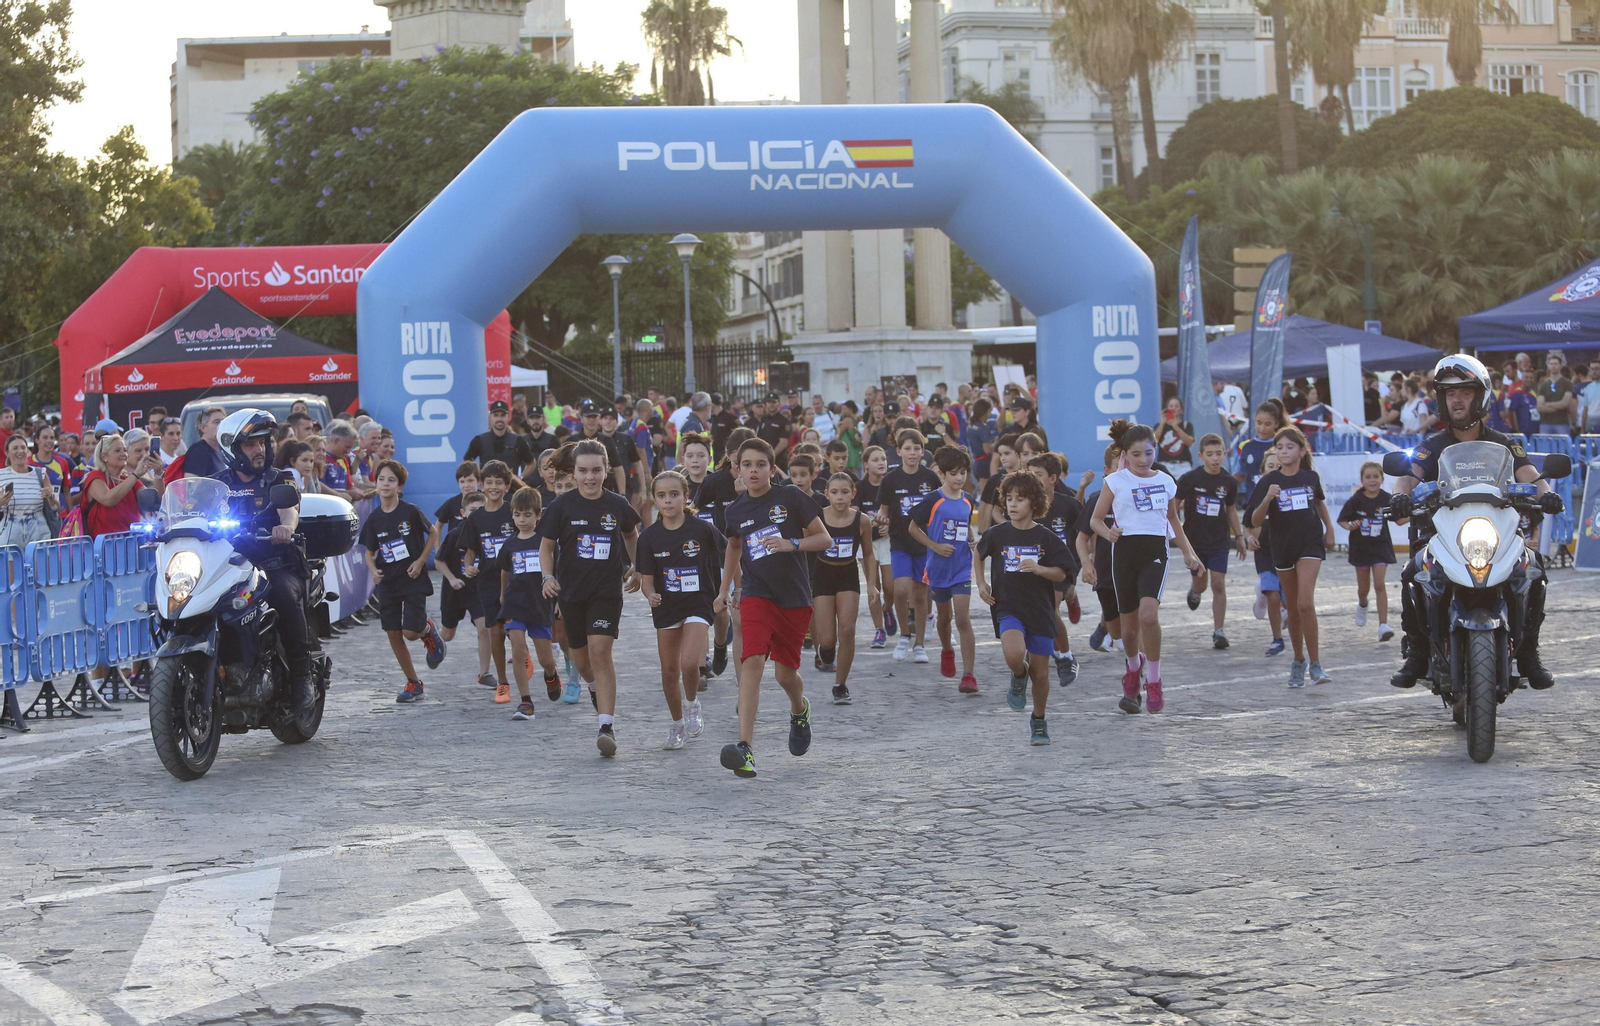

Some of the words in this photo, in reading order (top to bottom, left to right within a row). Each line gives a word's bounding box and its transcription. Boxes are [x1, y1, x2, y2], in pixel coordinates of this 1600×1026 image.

[750, 172, 914, 190] NACIONAL
[193, 267, 260, 290] Sports
[1092, 305, 1139, 337] RUTA
[174, 323, 277, 342] Evedeport
[401, 322, 453, 355] RUTA
[186, 344, 273, 352] www.evedeport.es
[212, 374, 255, 385] Santander
[309, 371, 352, 381] Santander
[114, 382, 158, 393] Santander
[402, 359, 456, 464] 091
